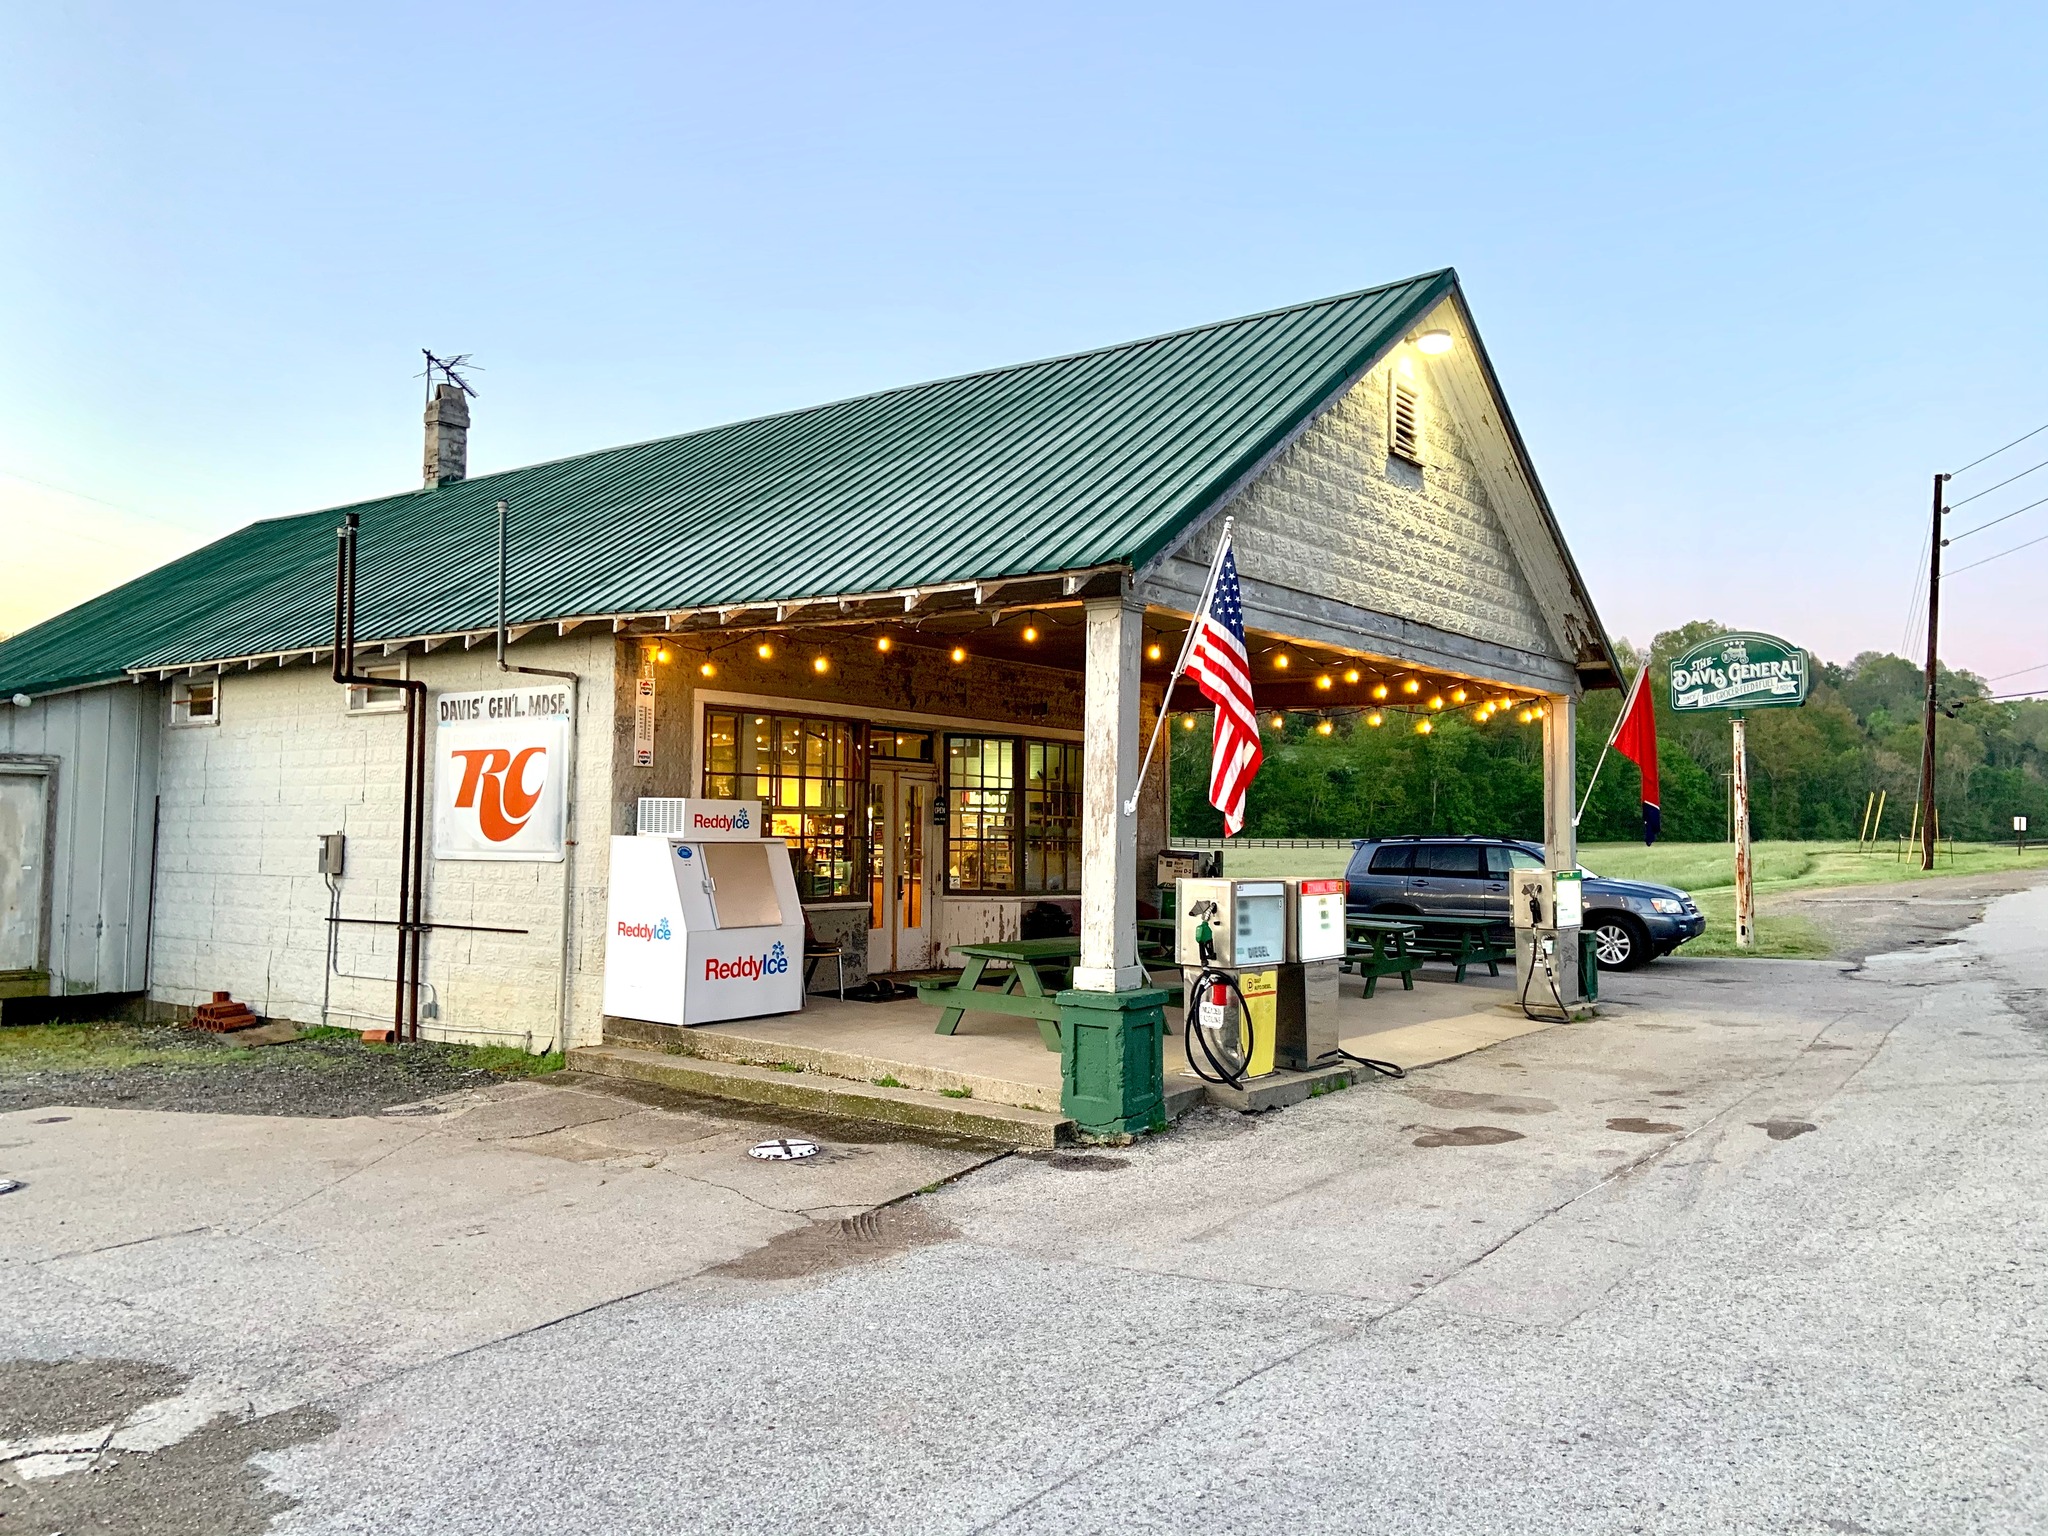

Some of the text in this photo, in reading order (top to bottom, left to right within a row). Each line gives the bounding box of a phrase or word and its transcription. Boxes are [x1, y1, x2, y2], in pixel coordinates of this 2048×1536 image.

[1672, 660, 1803, 691] DAVIS GENERAL
[441, 695, 485, 722] DAVIS'
[451, 746, 547, 842] RC
[1247, 945, 1271, 959] DIESEL
